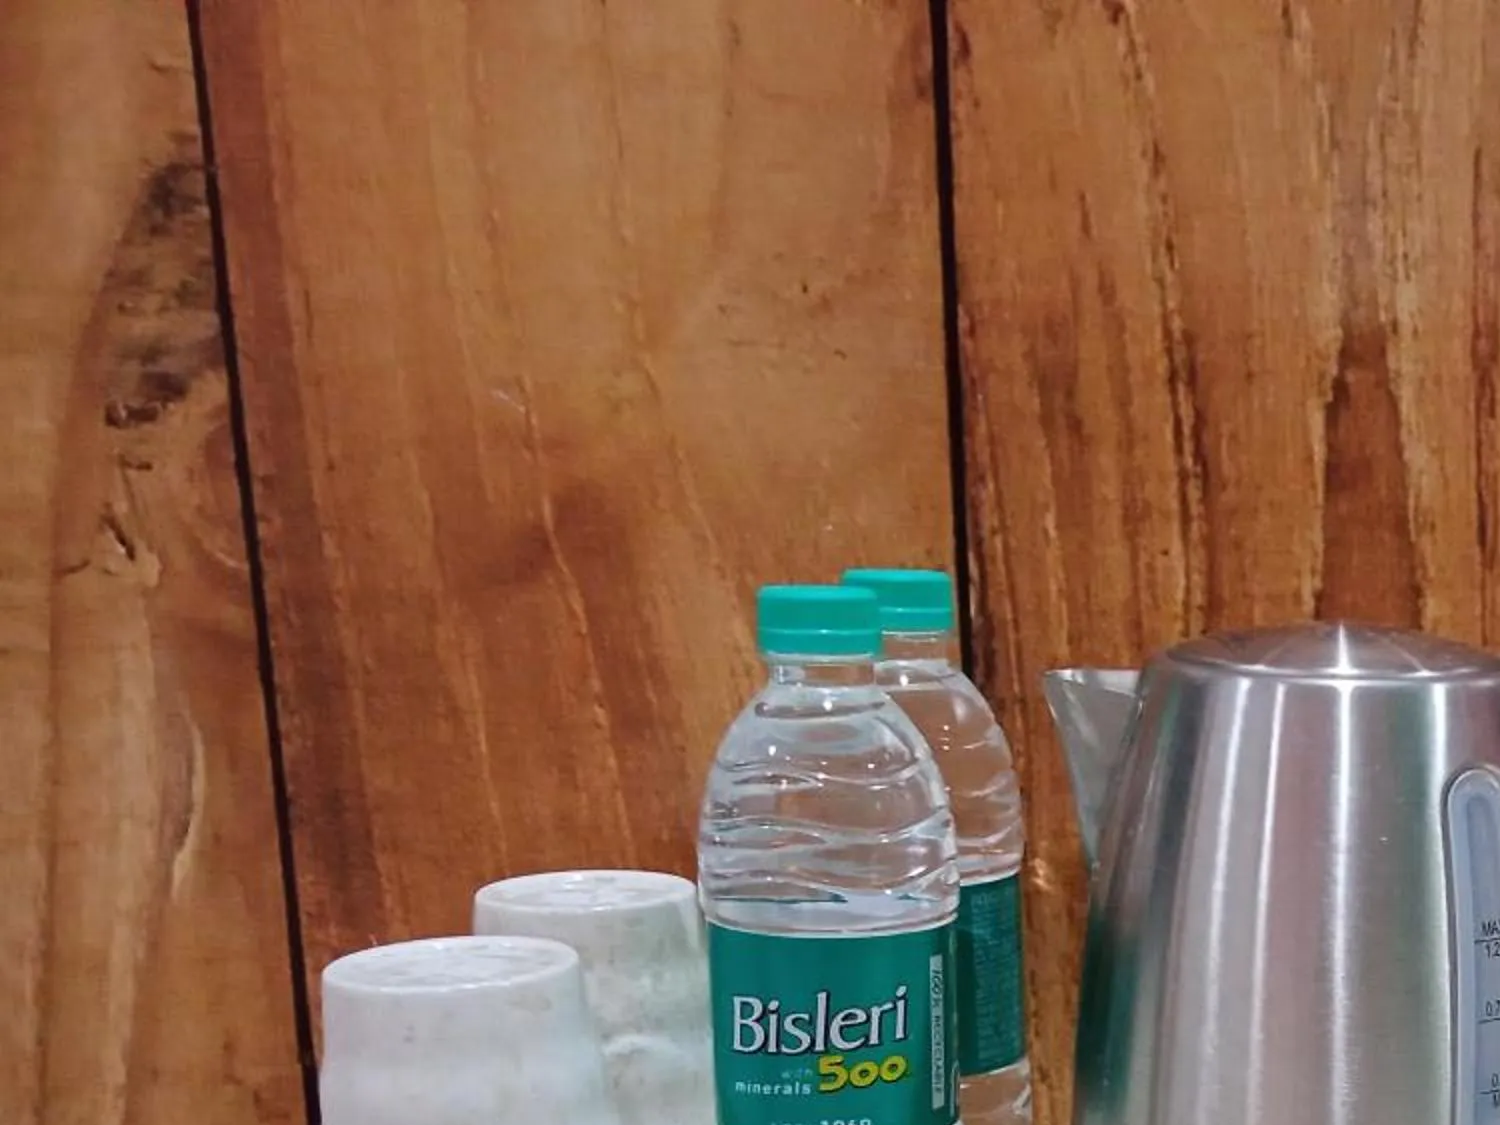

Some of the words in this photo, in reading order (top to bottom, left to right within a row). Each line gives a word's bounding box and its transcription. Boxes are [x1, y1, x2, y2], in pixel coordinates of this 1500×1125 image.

[732, 984, 907, 1055] Bisleri
[735, 1081, 812, 1095] minerals
[818, 1054, 907, 1092] 500
